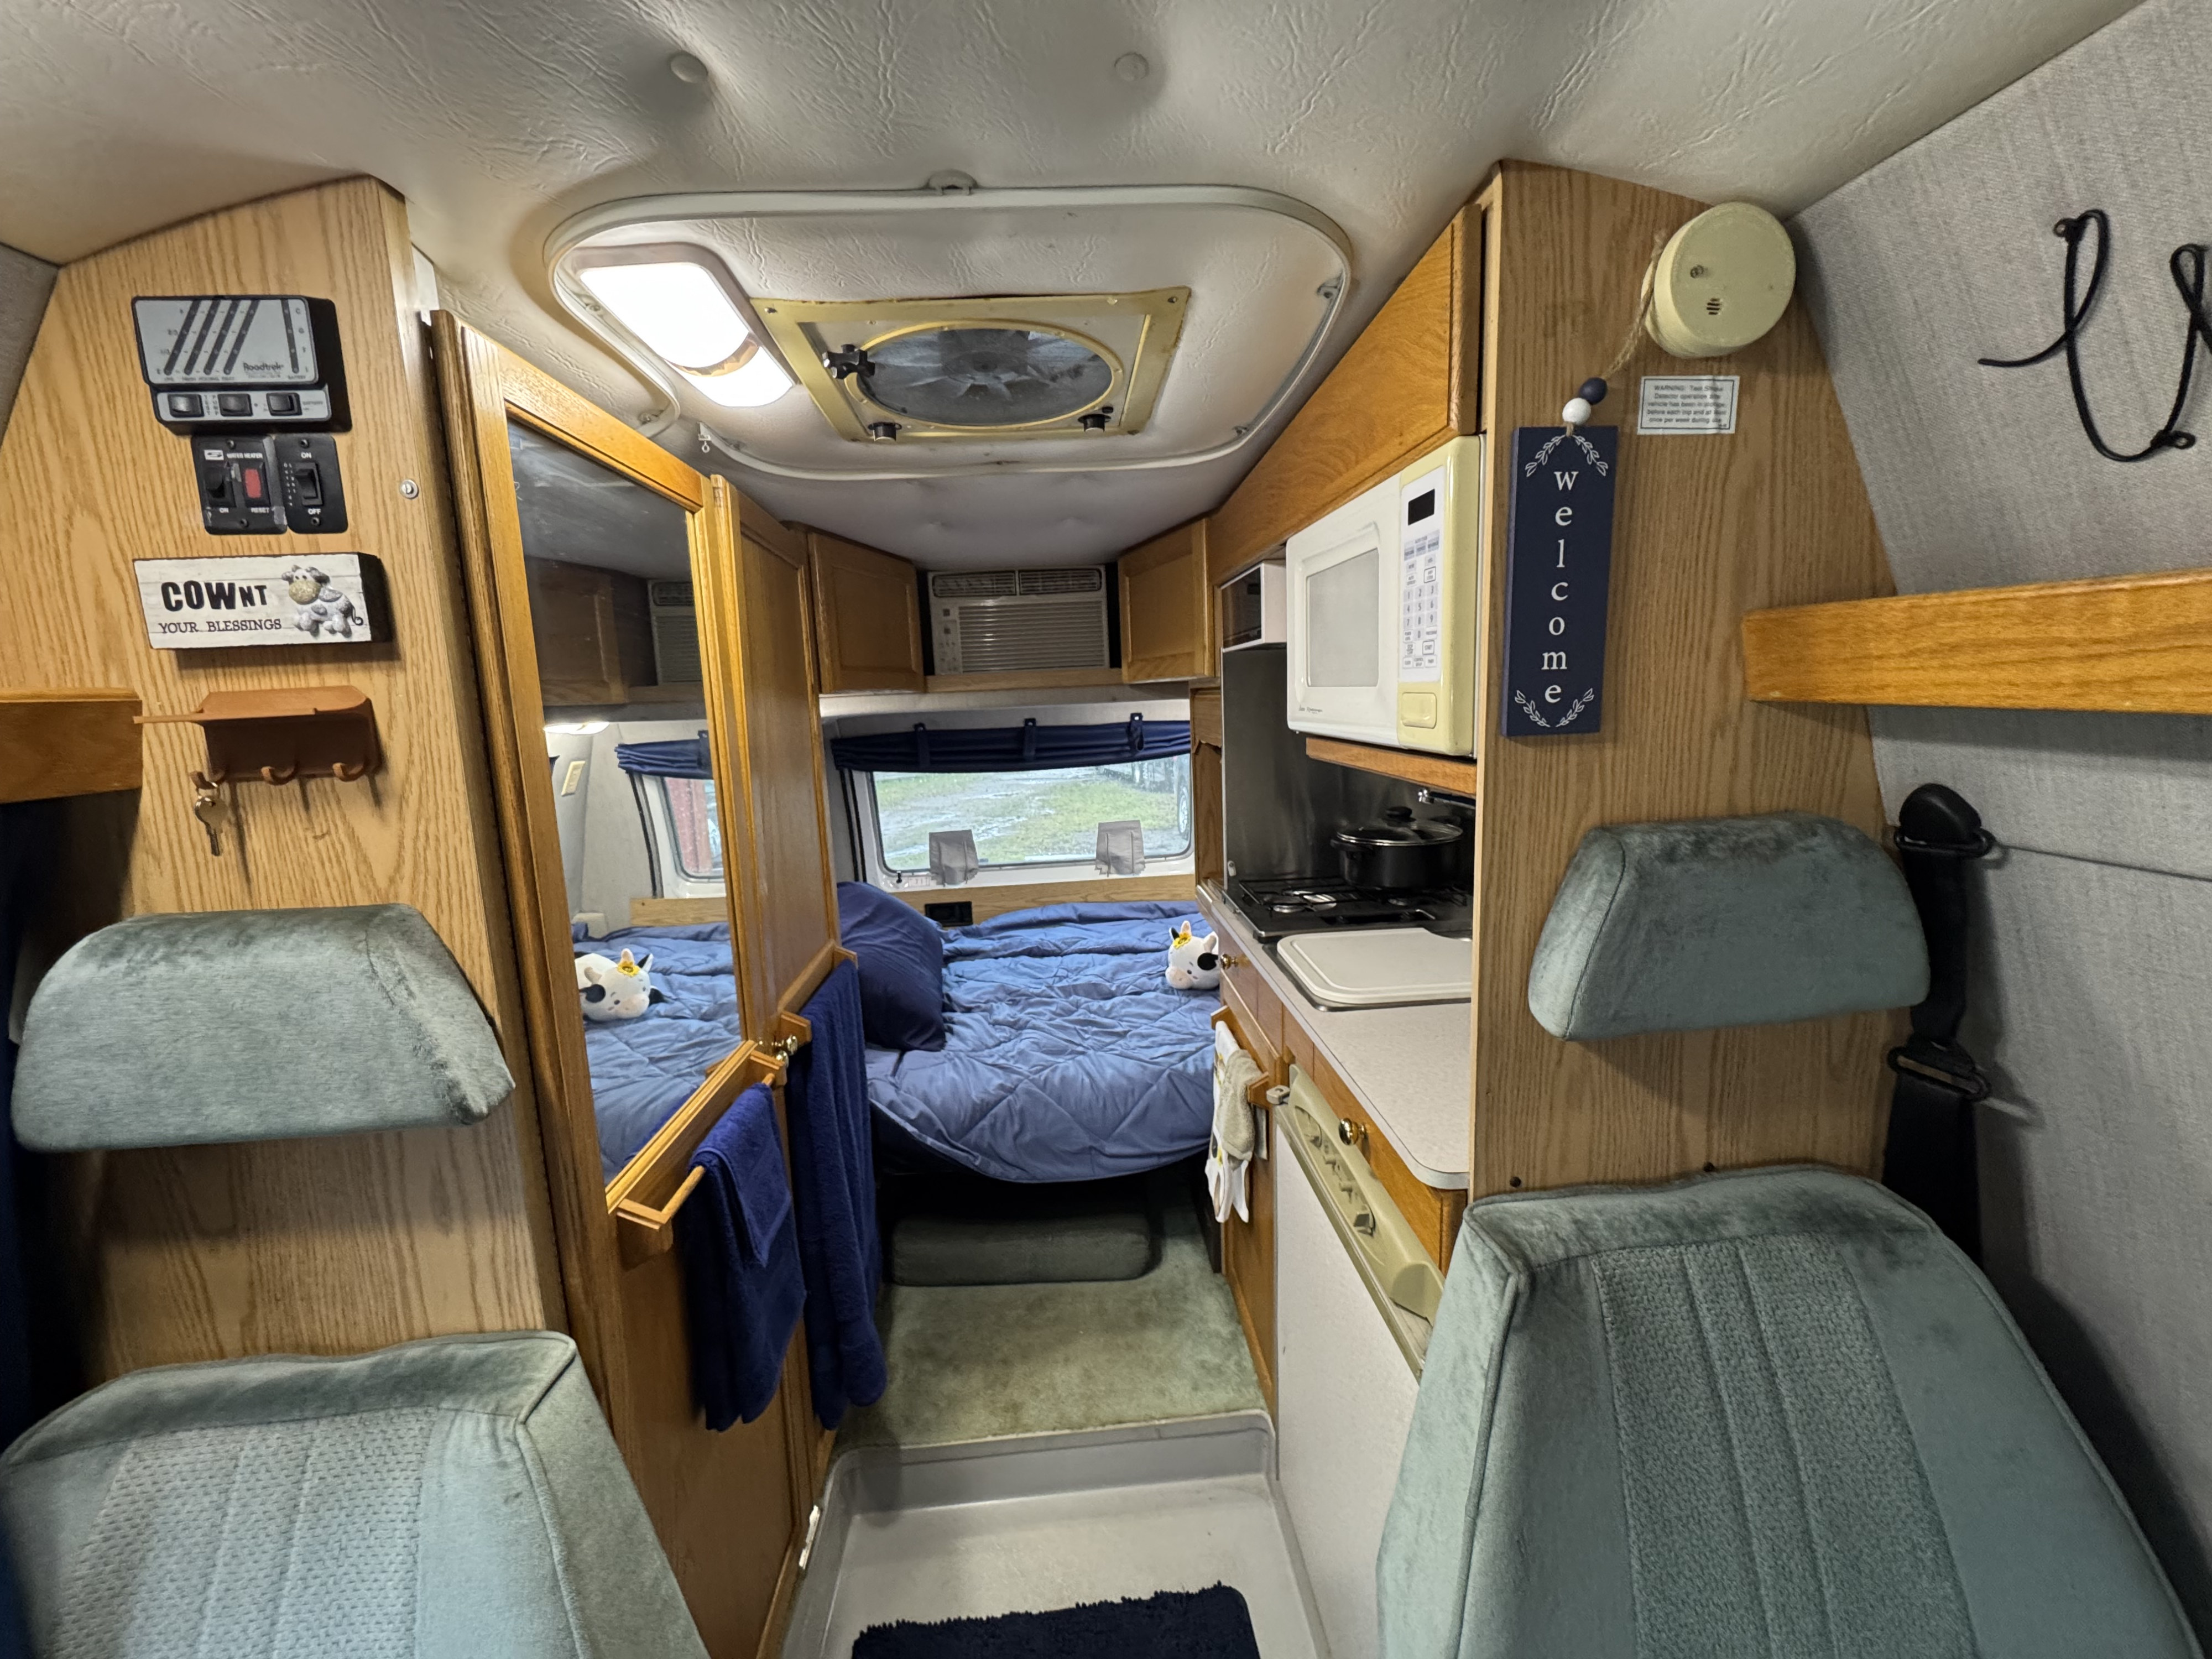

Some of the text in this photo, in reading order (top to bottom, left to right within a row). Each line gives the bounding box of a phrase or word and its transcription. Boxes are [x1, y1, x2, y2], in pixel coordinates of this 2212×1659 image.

[243, 361, 281, 371] Roadtrek
[1431, 586, 1434, 594] 3
[1541, 471, 1579, 704] welcome
[1418, 588, 1422, 597] 2
[1407, 604, 1410, 613] 4
[1418, 602, 1422, 611] 5
[1430, 600, 1434, 608] 6
[1430, 614, 1433, 623] 9
[158, 618, 282, 634] YOUR BLESSINGS
